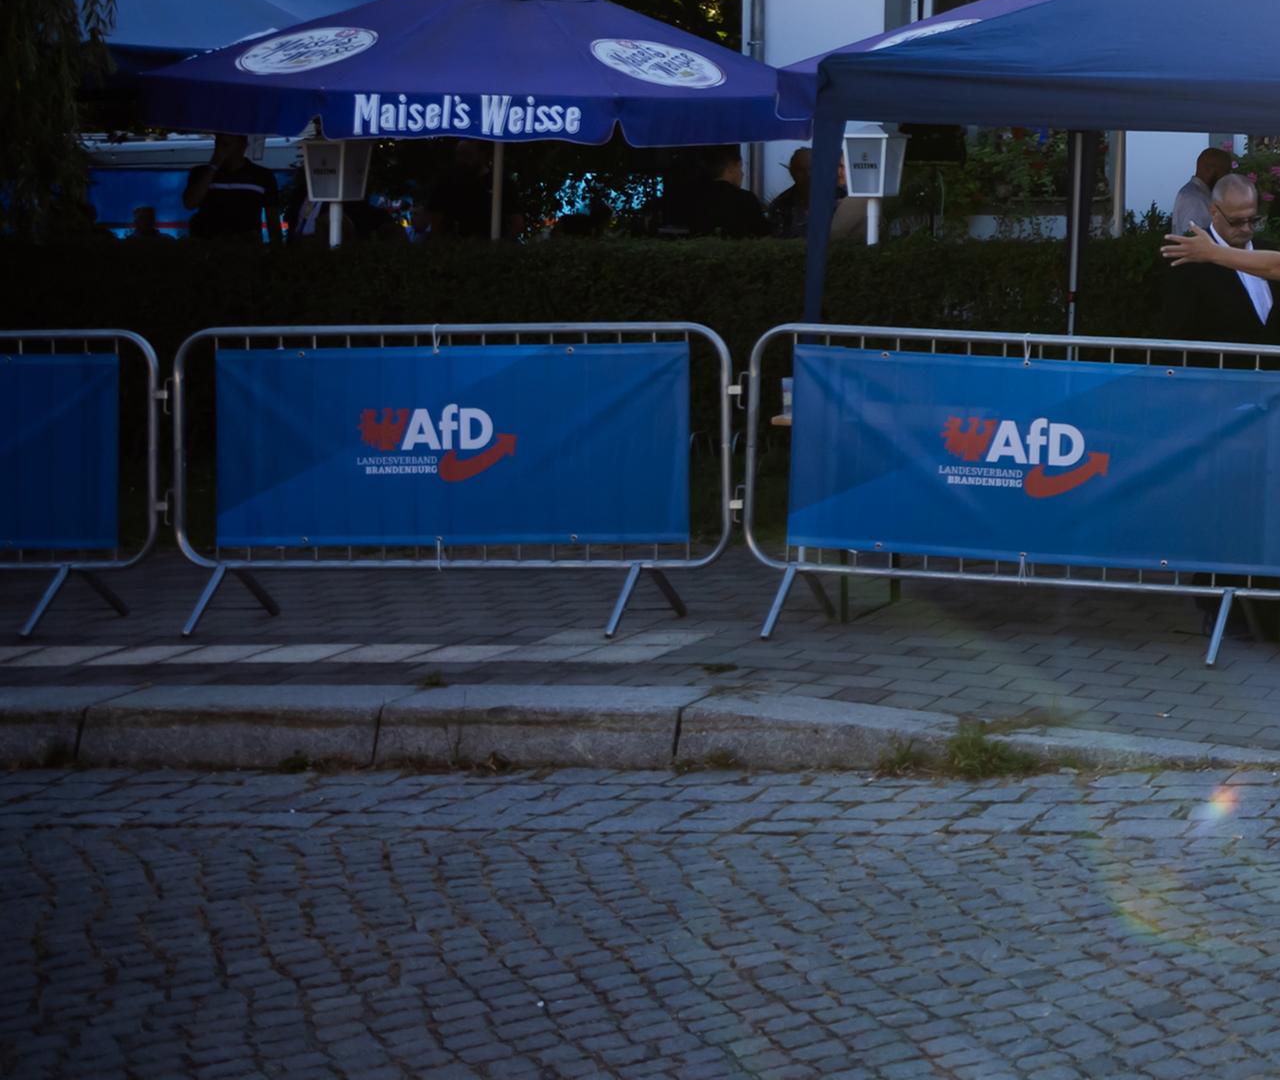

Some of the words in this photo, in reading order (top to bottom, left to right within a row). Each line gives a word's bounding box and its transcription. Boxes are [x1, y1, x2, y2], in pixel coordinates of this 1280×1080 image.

[353, 94, 471, 136] Maisel's
[480, 94, 583, 136] Weisse
[401, 403, 493, 451] AfD
[985, 418, 1085, 466] AfD
[356, 456, 438, 466] LANDESVERBAND
[365, 465, 438, 475] BRANDENBURG
[938, 465, 1023, 479] LANDESVERBAND
[947, 475, 1023, 488] BRANDENBURG
